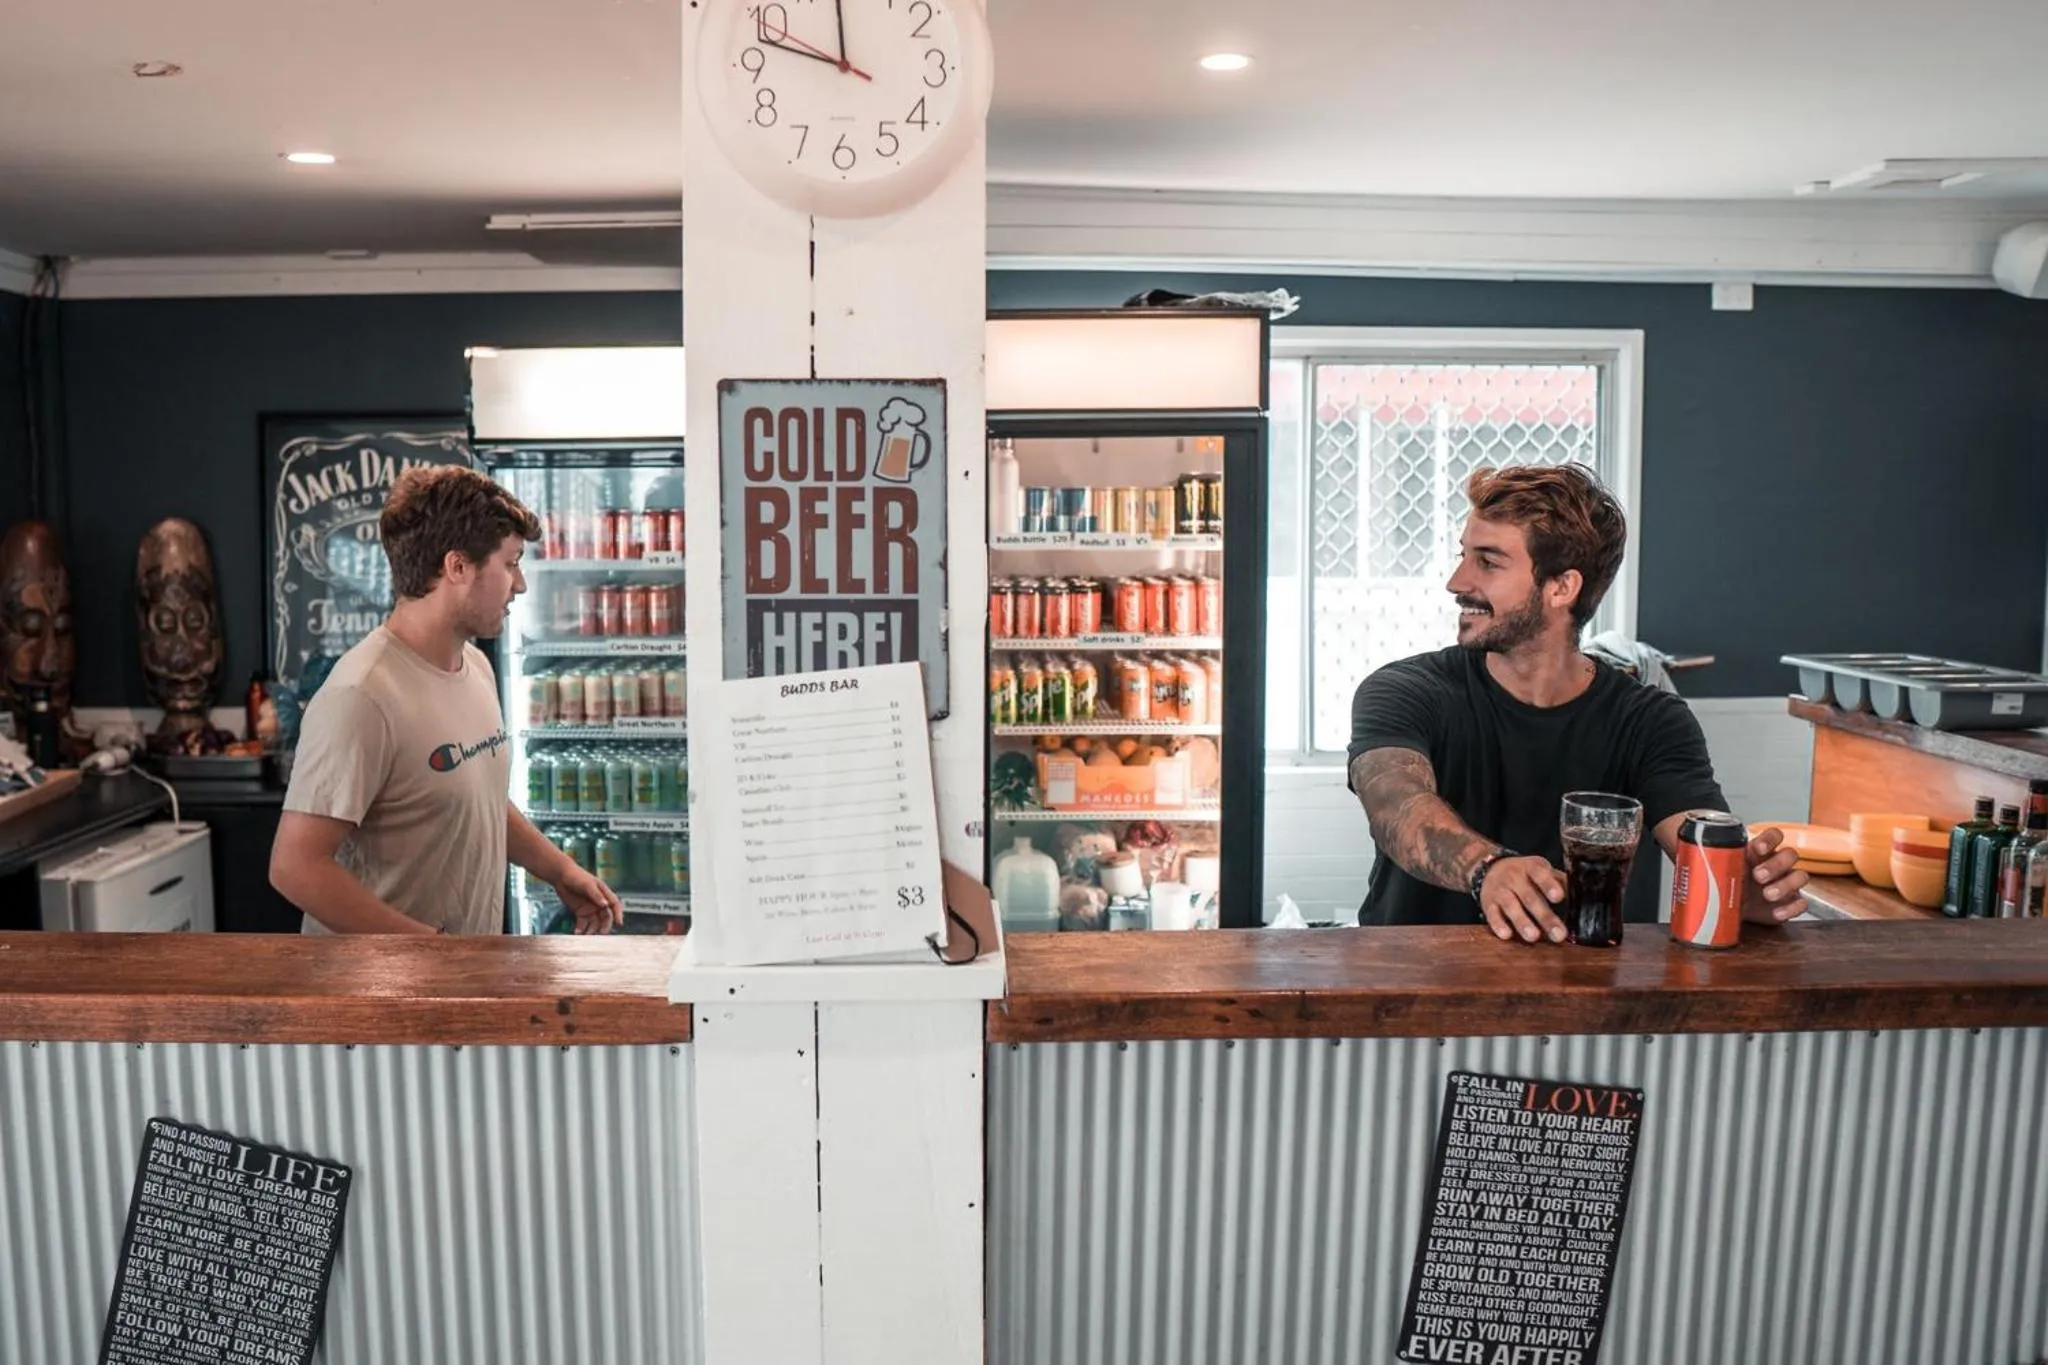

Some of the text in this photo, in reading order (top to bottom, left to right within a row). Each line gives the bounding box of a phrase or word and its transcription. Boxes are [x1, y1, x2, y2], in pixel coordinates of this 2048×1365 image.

[751, 3, 787, 42] 10
[909, 1, 931, 38] 2
[741, 47, 765, 83] 9
[924, 49, 946, 88] 3
[755, 88, 777, 127] 8
[905, 96, 928, 131] 4
[790, 124, 809, 159] 7
[832, 134, 856, 170] 6
[876, 121, 899, 157] 5
[743, 407, 866, 482] COLD
[288, 460, 357, 514] JACK
[744, 486, 919, 595] BEER
[780, 678, 858, 698] BUDDS BAR
[897, 885, 925, 912] $3
[1458, 1075, 1524, 1093] FALL IN
[1523, 1083, 1638, 1119] LOVE.
[1451, 1119, 1467, 1131] BE
[1470, 1121, 1541, 1138] THOUGHTFUL
[1544, 1129, 1569, 1141] AND
[1453, 1104, 1635, 1133] LISTEN TO YOUR HEART.
[152, 1137, 232, 1168] AND PURSUE IT.
[179, 1130, 186, 1141] A
[189, 1132, 231, 1153] PASSION
[1448, 1132, 1631, 1161] BELIEVE IN LOVE AT FIRST SIGHT.
[235, 1145, 339, 1195] LIFE
[1446, 1146, 1476, 1159] HOLD
[1522, 1154, 1559, 1167] LAUGH
[1561, 1158, 1628, 1173] NERVOUSLY.
[149, 1150, 340, 1210] FALL IN LOVE. DREAM BIG.
[1442, 1166, 1624, 1192] GET DRESSED UP FOR A DATE.
[143, 1181, 332, 1240] BELIEVE IN MAGIC. TELL STORIES.
[246, 1198, 279, 1213] LAUGH
[1435, 1201, 1617, 1231] STAY IN BED ALL DAY.
[1438, 1187, 1619, 1216] RUN AWAY TOGETHER.
[136, 1213, 324, 1270] LEARN MORE. BE CREATIVE.
[1431, 1227, 1522, 1243] GRANDCHILDREN
[1428, 1238, 1610, 1266] LEARN FROM EACH OTHER.
[125, 1266, 144, 1278] BE
[150, 1272, 185, 1289] TRUE
[191, 1282, 208, 1294] TO
[213, 1288, 246, 1304] WHO
[250, 1297, 278, 1312] YOU
[130, 1243, 319, 1303] LOVE WITH ALL YOUR HEART.
[1423, 1262, 1604, 1292] GROW OLD TOGETHER.
[1418, 1290, 1600, 1317] KISS EACH OTHER GOODNIGHT.
[1420, 1277, 1602, 1305] BE SPONTANEOUS AND IMPULSIVE.
[121, 1292, 162, 1309] SMILE
[166, 1303, 214, 1321] OFTEN.
[217, 1315, 234, 1326] BE
[1416, 1302, 1474, 1318] REMEMBER
[1477, 1309, 1500, 1320] WHY
[1503, 1311, 1523, 1323] YOU
[1524, 1313, 1547, 1325] FELL
[1549, 1315, 1561, 1326] IN
[115, 1325, 223, 1358] TRY NEW THINGS.
[116, 1310, 182, 1336] FOLLOW
[187, 1326, 229, 1348] YOUR
[1415, 1315, 1594, 1348] THIS IS YOUR HAPPILY
[1408, 1335, 1484, 1364] EVER
